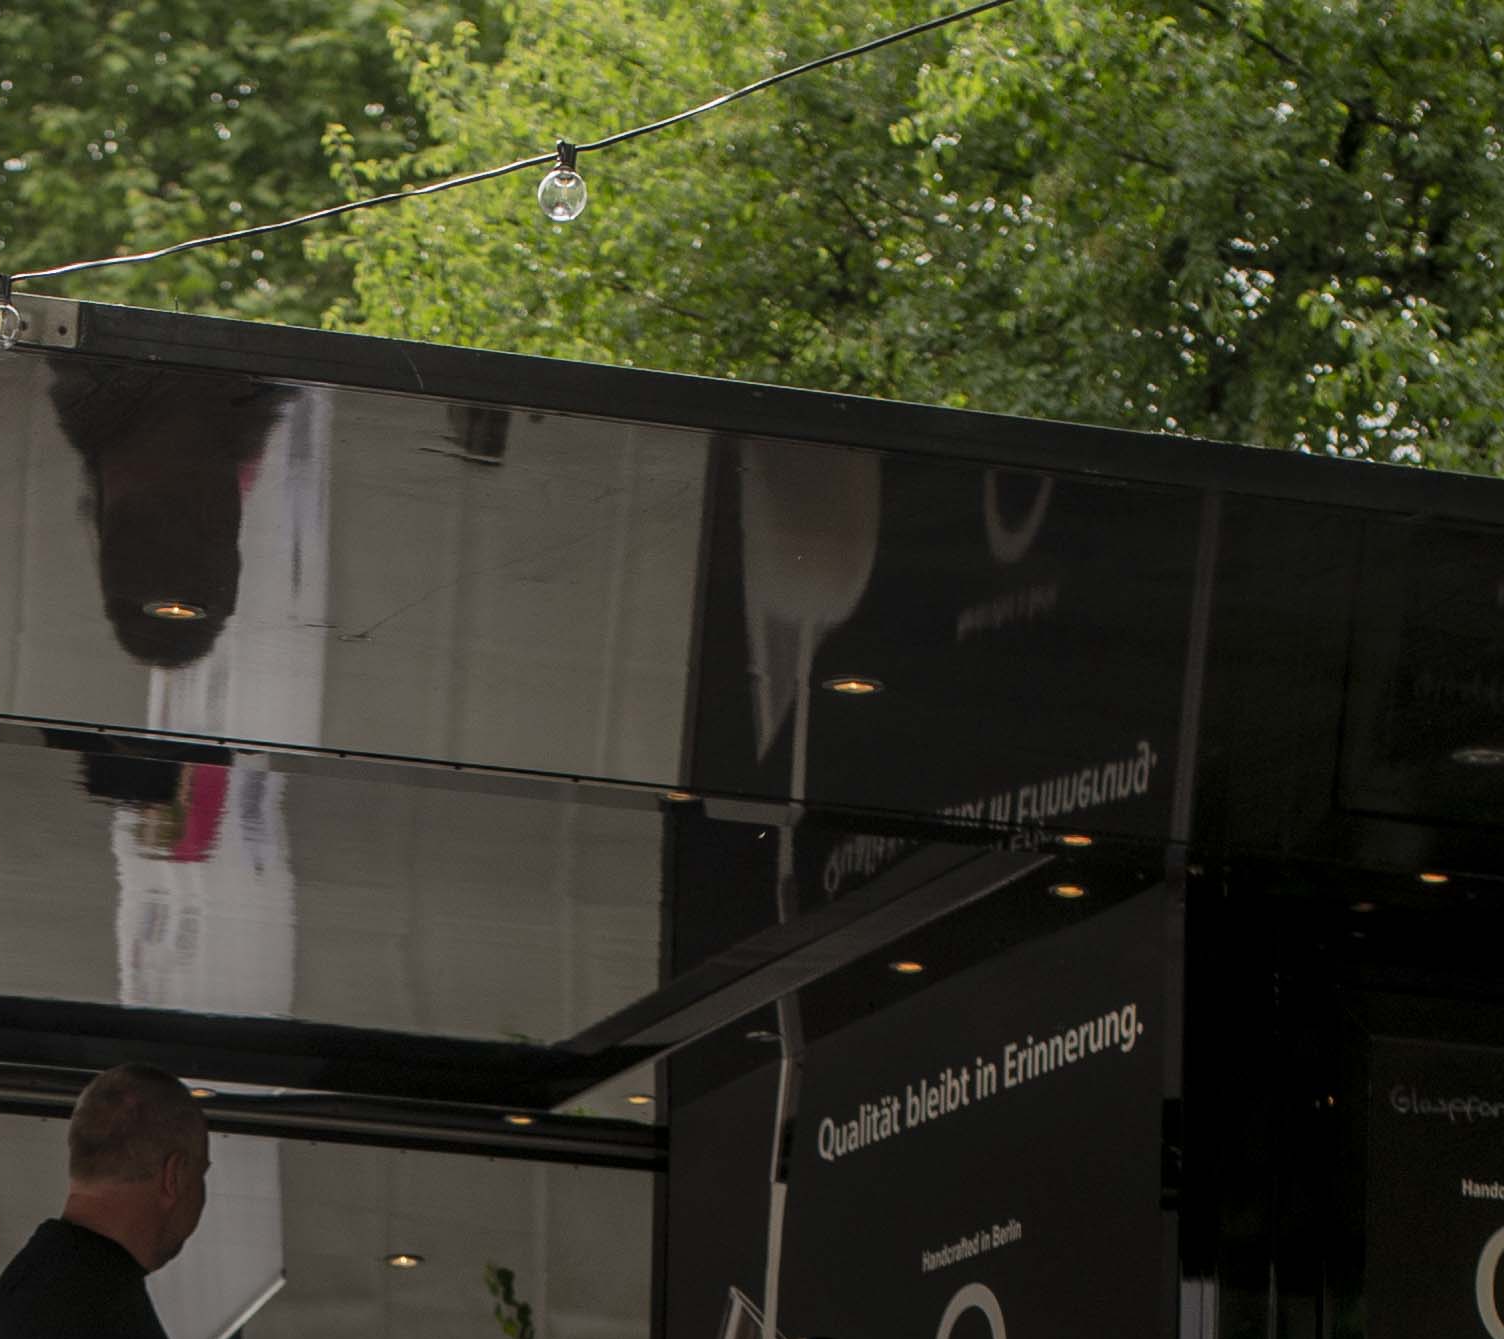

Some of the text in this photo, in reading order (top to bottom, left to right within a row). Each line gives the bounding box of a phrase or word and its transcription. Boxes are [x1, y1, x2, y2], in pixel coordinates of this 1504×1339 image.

[818, 1003, 1144, 1163] Qualität bleibt in Erinnerung.
[922, 1218, 1023, 1273] Handcrafted in Berlin
